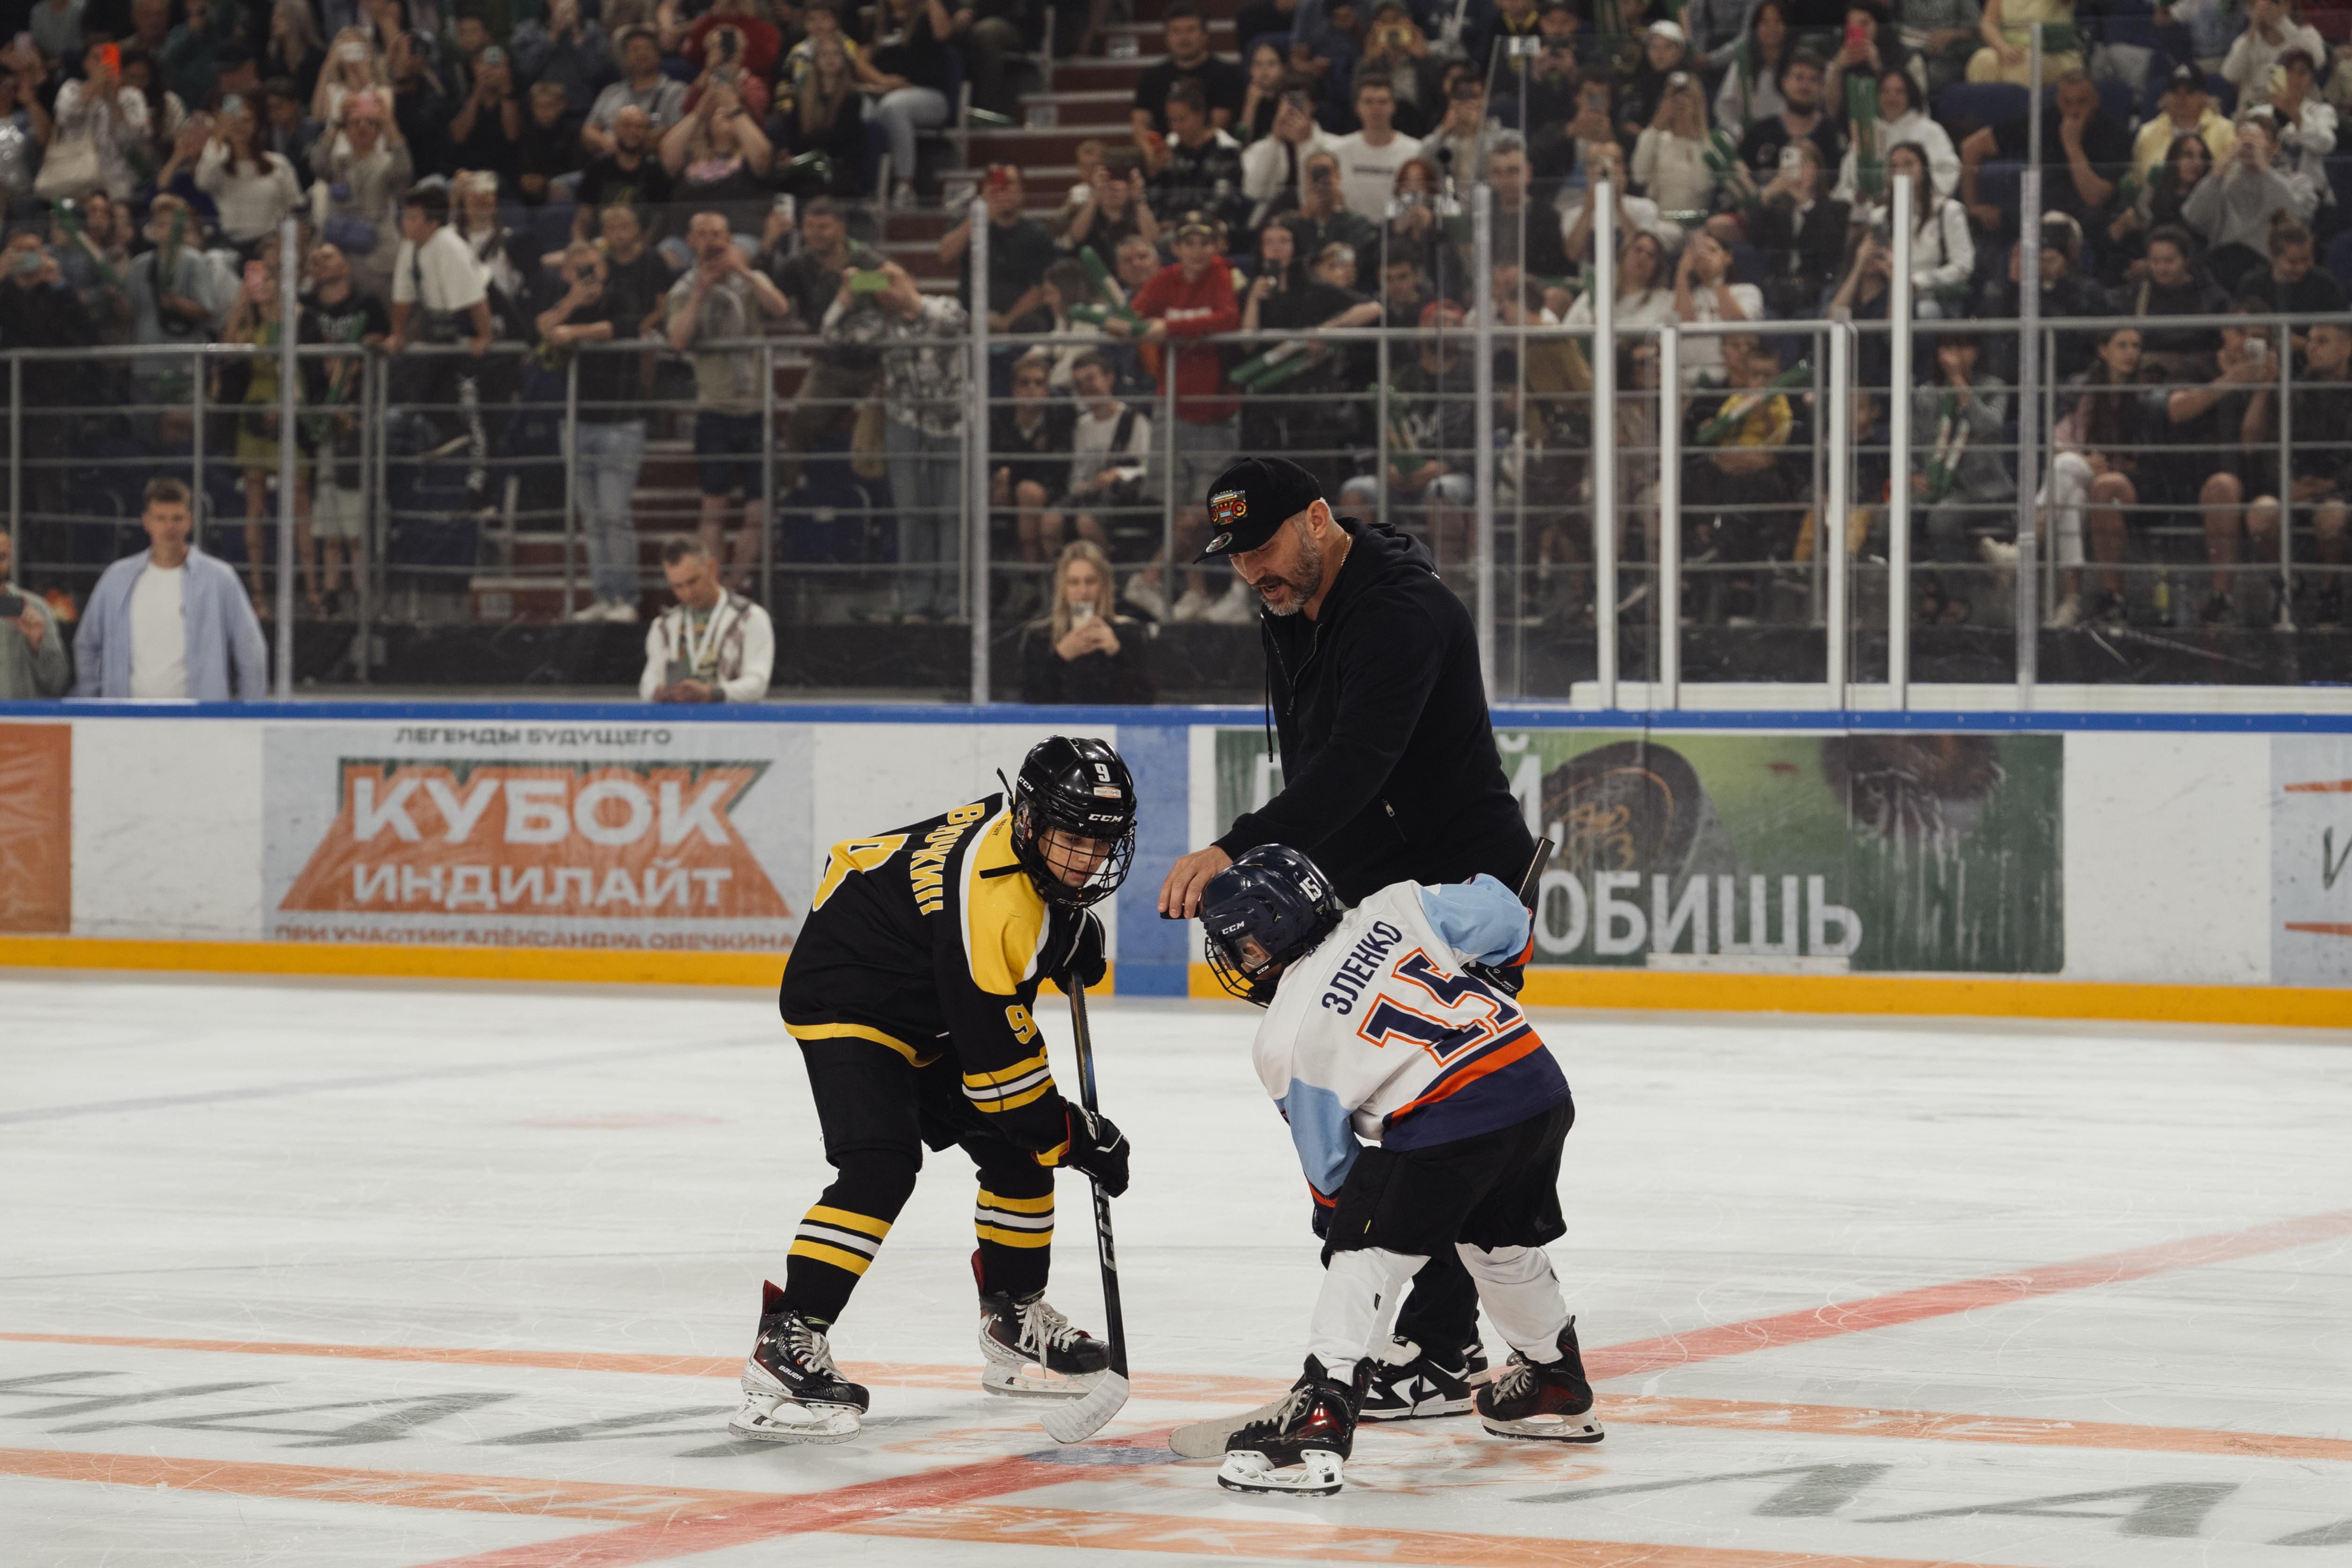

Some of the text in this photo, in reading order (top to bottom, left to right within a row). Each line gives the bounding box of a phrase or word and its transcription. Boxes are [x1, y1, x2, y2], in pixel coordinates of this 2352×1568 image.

[394, 727, 672, 747] ЛЕГЕНДЫ БУДУЩЕГО
[1018, 776, 1034, 792] CCM
[1094, 763, 1110, 782] 9
[354, 777, 735, 846] КУБОК
[1088, 814, 1124, 823] CCM
[354, 858, 733, 910] ИНДИЛАЙТ
[1299, 877, 1322, 902] 15
[276, 924, 328, 942] ПРИ
[649, 931, 795, 950] ОВЕЧКИНА
[1221, 920, 1245, 935] CCM
[1257, 964, 1269, 975] CCM
[1321, 920, 1402, 1015] ЗЛЕНКО
[1357, 947, 1523, 1068] 15
[1005, 1003, 1037, 1044] 9
